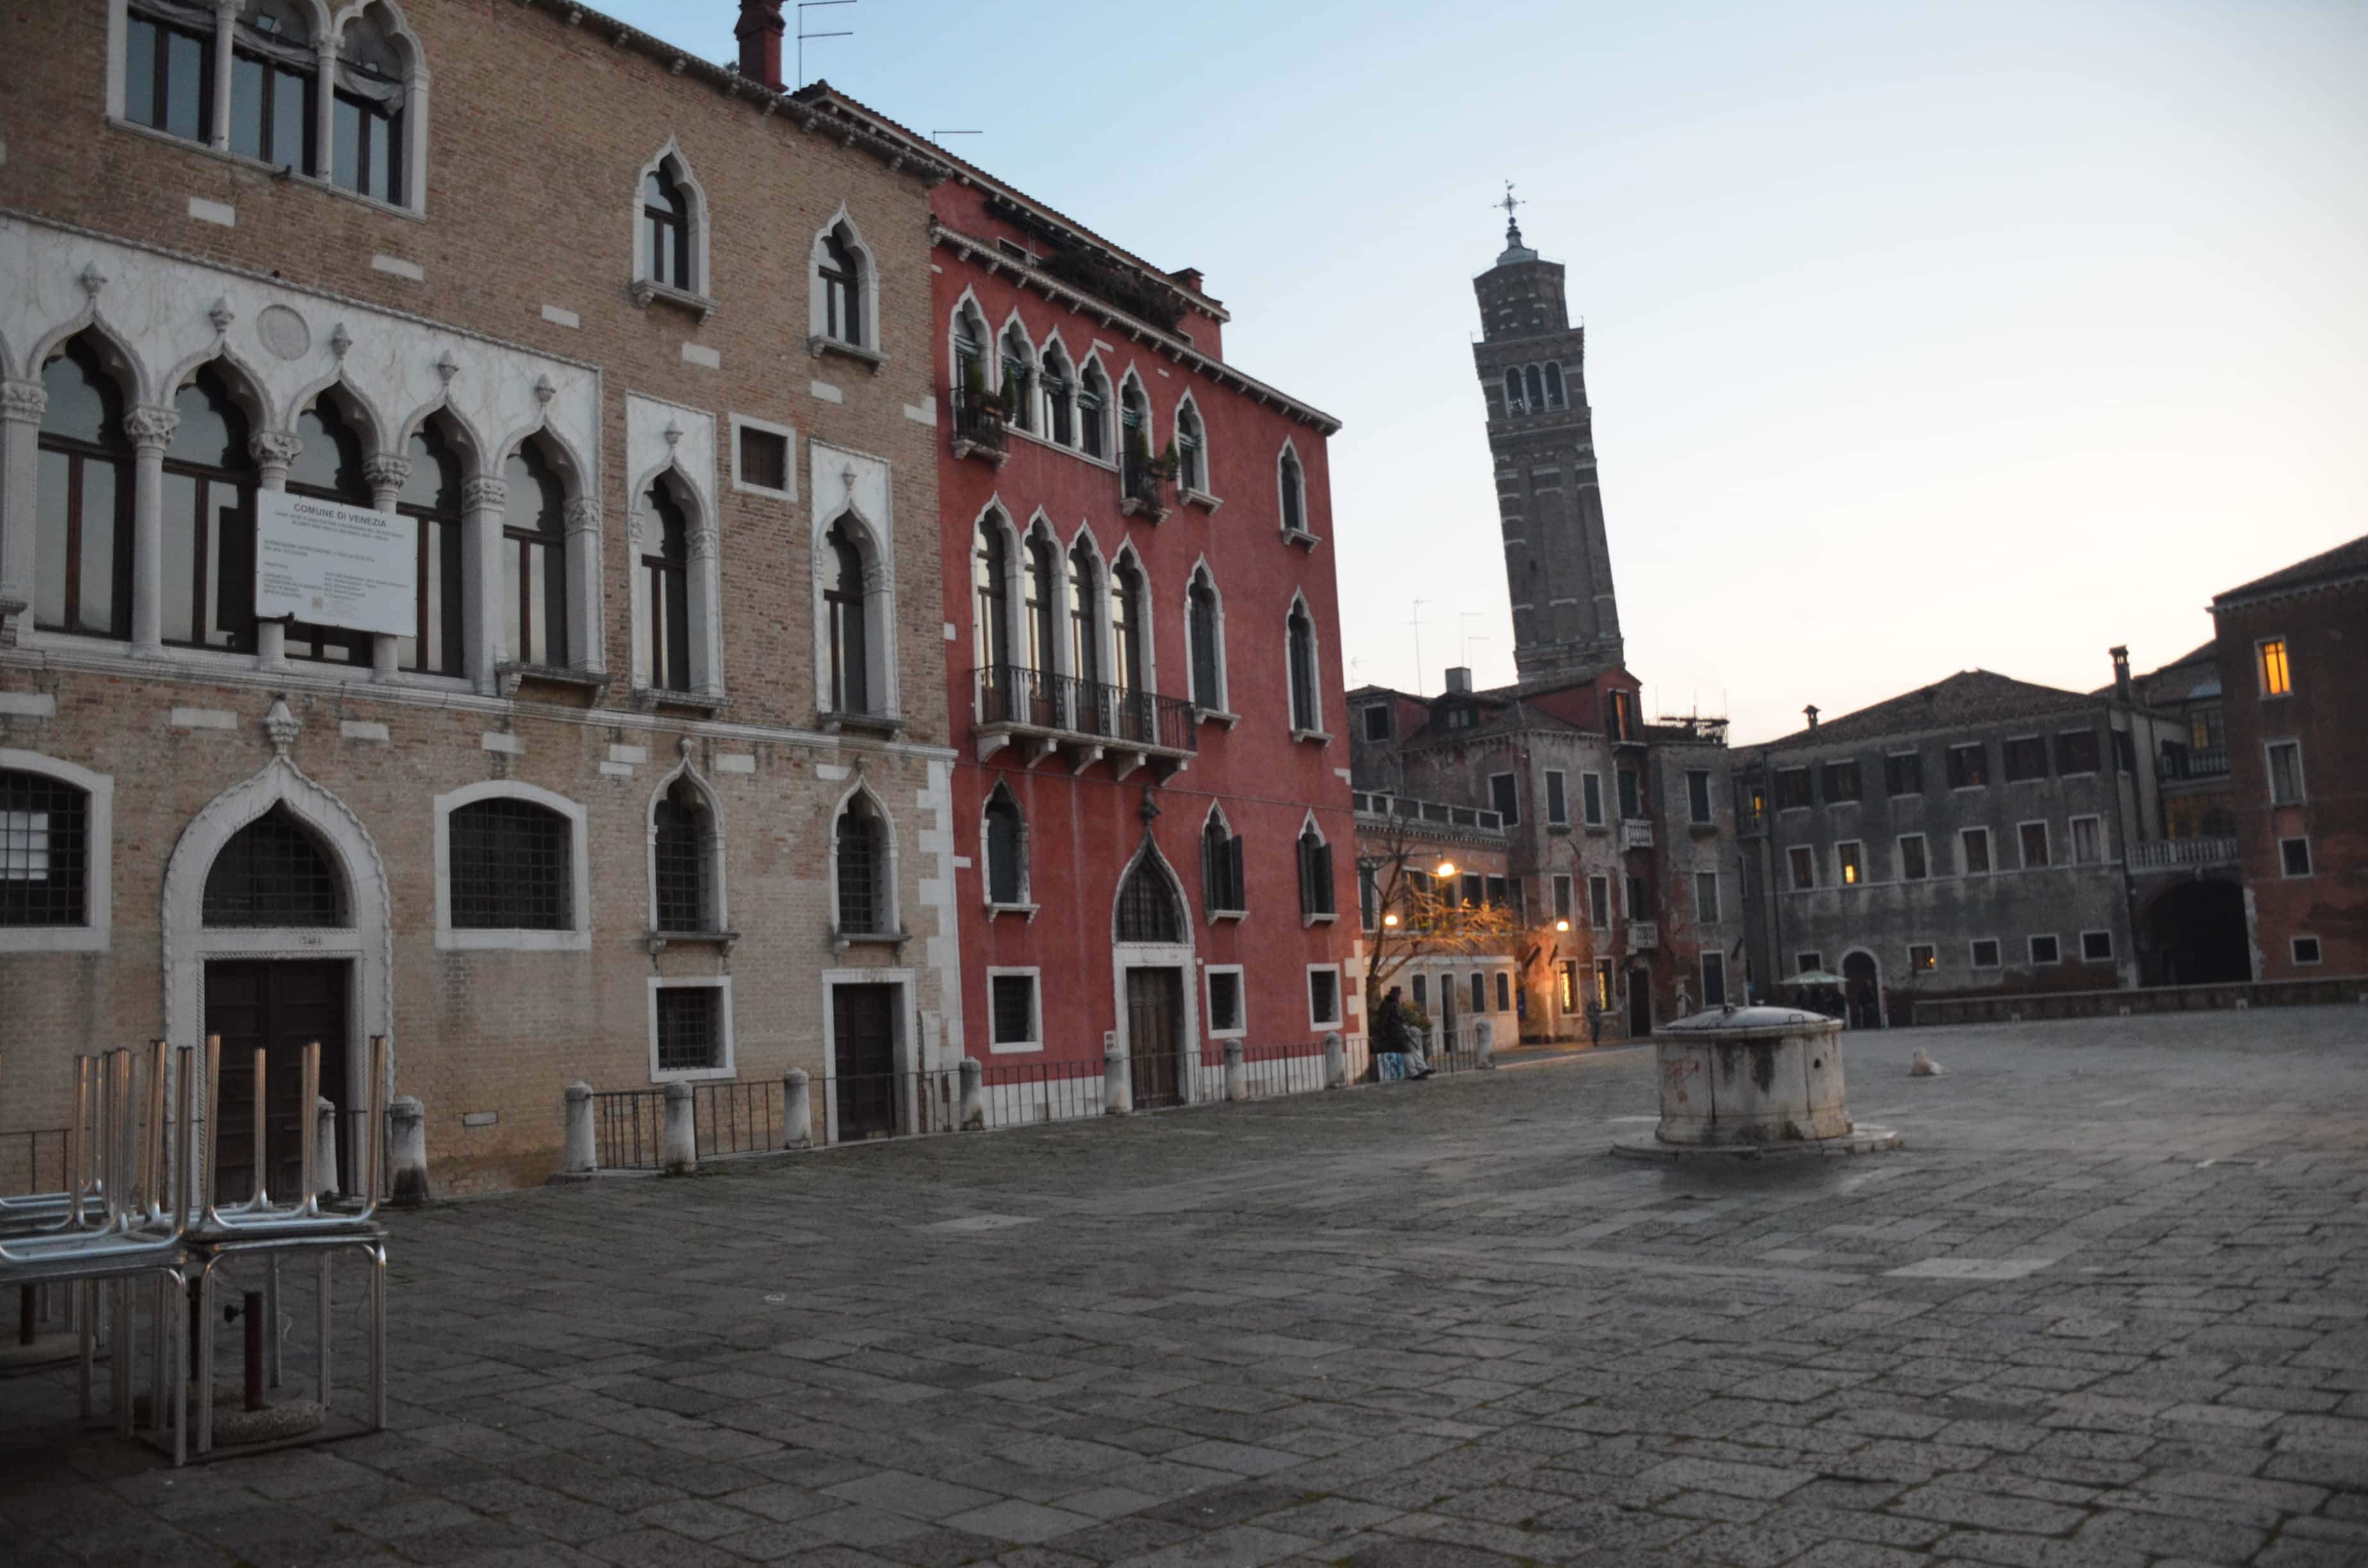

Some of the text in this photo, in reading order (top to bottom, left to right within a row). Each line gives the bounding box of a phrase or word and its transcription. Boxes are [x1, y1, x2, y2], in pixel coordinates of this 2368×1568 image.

[294, 503, 334, 518] COMUNE
[338, 512, 345, 520] DI
[349, 514, 386, 527] VENEZIA
